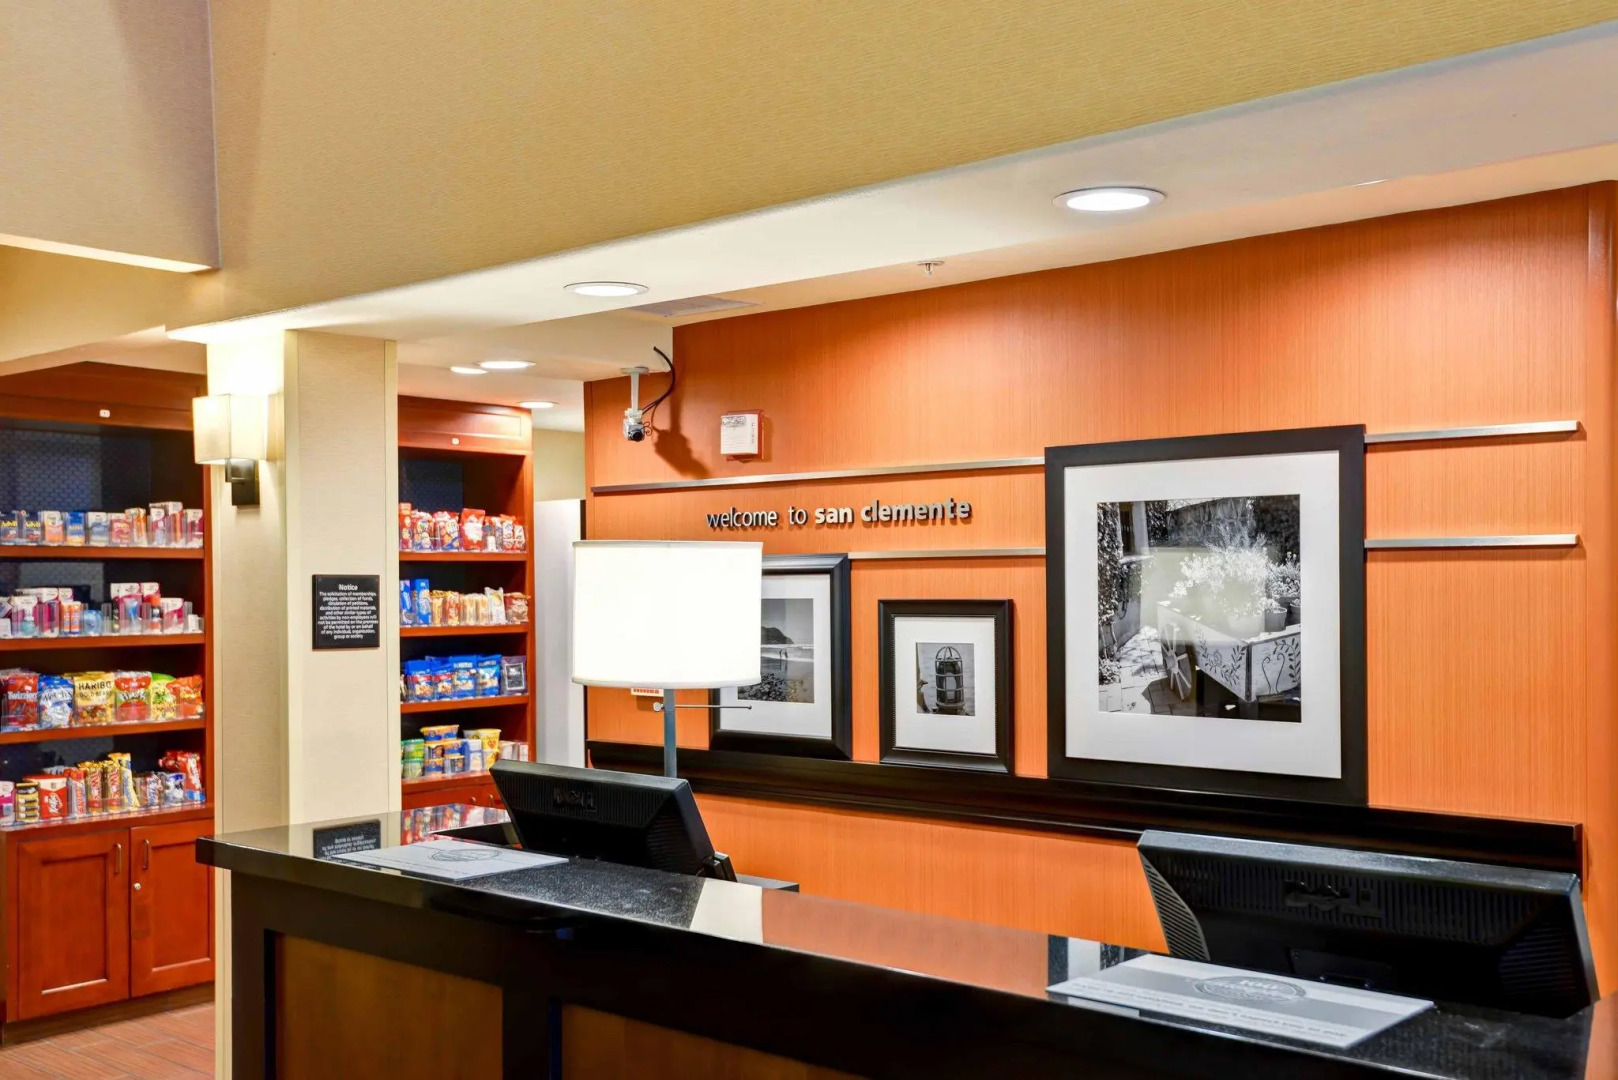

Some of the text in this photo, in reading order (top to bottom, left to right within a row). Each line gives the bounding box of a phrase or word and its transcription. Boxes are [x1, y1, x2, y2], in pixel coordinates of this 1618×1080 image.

[706, 498, 971, 528] welcome to san clemente
[78, 681, 112, 690] HARIBO
